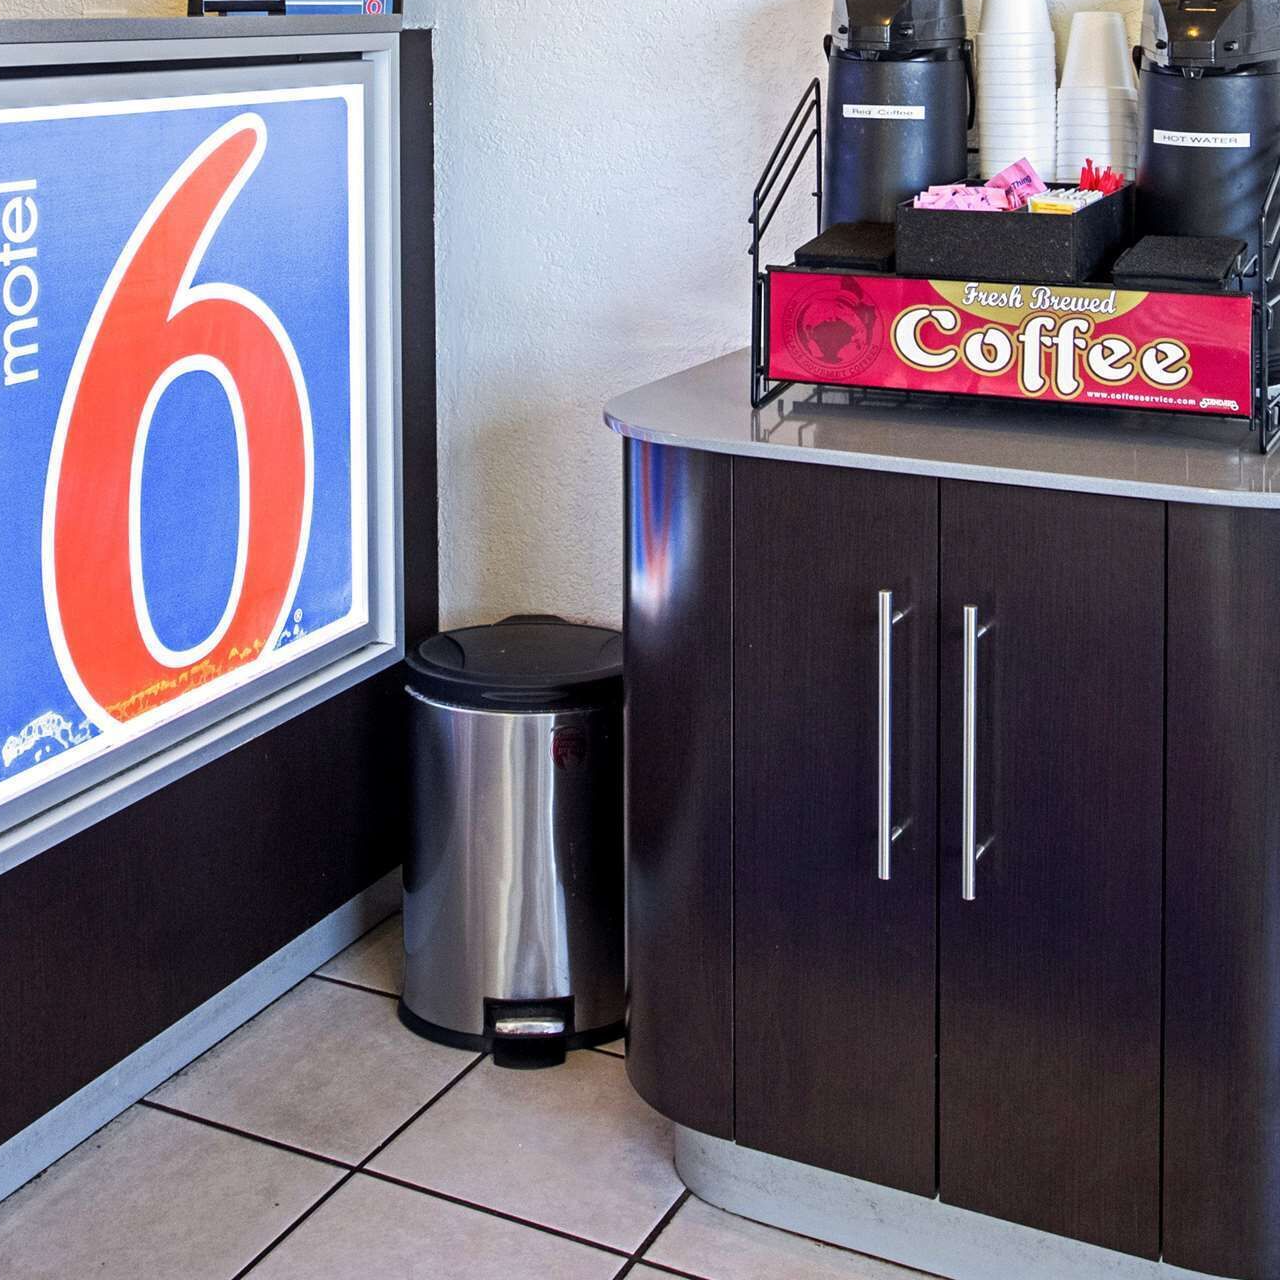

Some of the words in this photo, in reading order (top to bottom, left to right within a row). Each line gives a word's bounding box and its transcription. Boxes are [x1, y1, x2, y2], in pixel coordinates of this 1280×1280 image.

[1163, 135, 1185, 143] HOT
[1190, 136, 1238, 144] WATER
[1011, 175, 1032, 190] Thing
[962, 282, 1024, 308] Fresh
[1030, 286, 1117, 314] Brewed
[893, 308, 1190, 396] Coffee
[1086, 391, 1196, 406] www.coffeeservice.com
[41, 112, 314, 724] 6
